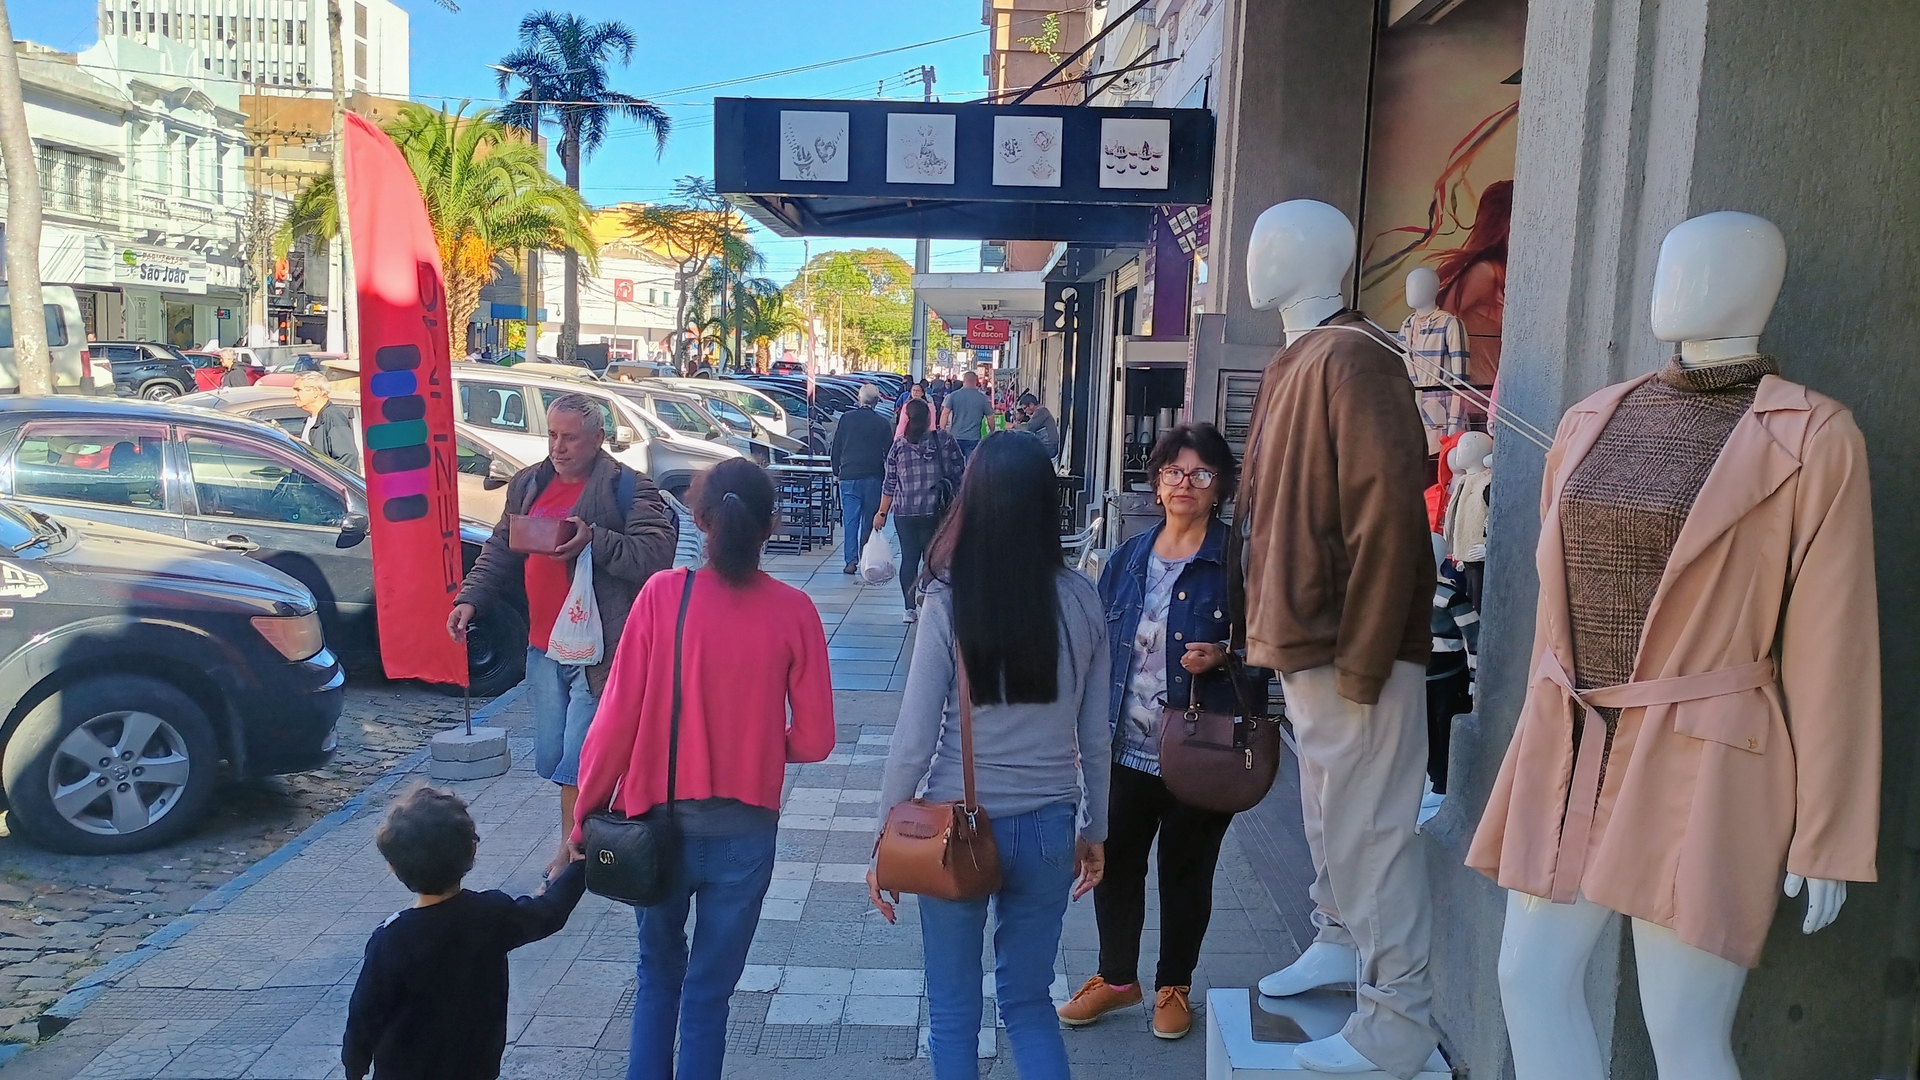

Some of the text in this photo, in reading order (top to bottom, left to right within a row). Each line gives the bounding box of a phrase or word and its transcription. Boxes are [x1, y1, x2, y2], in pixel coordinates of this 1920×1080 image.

[140, 263, 186, 284] São João
[972, 330, 1004, 338] brascon
